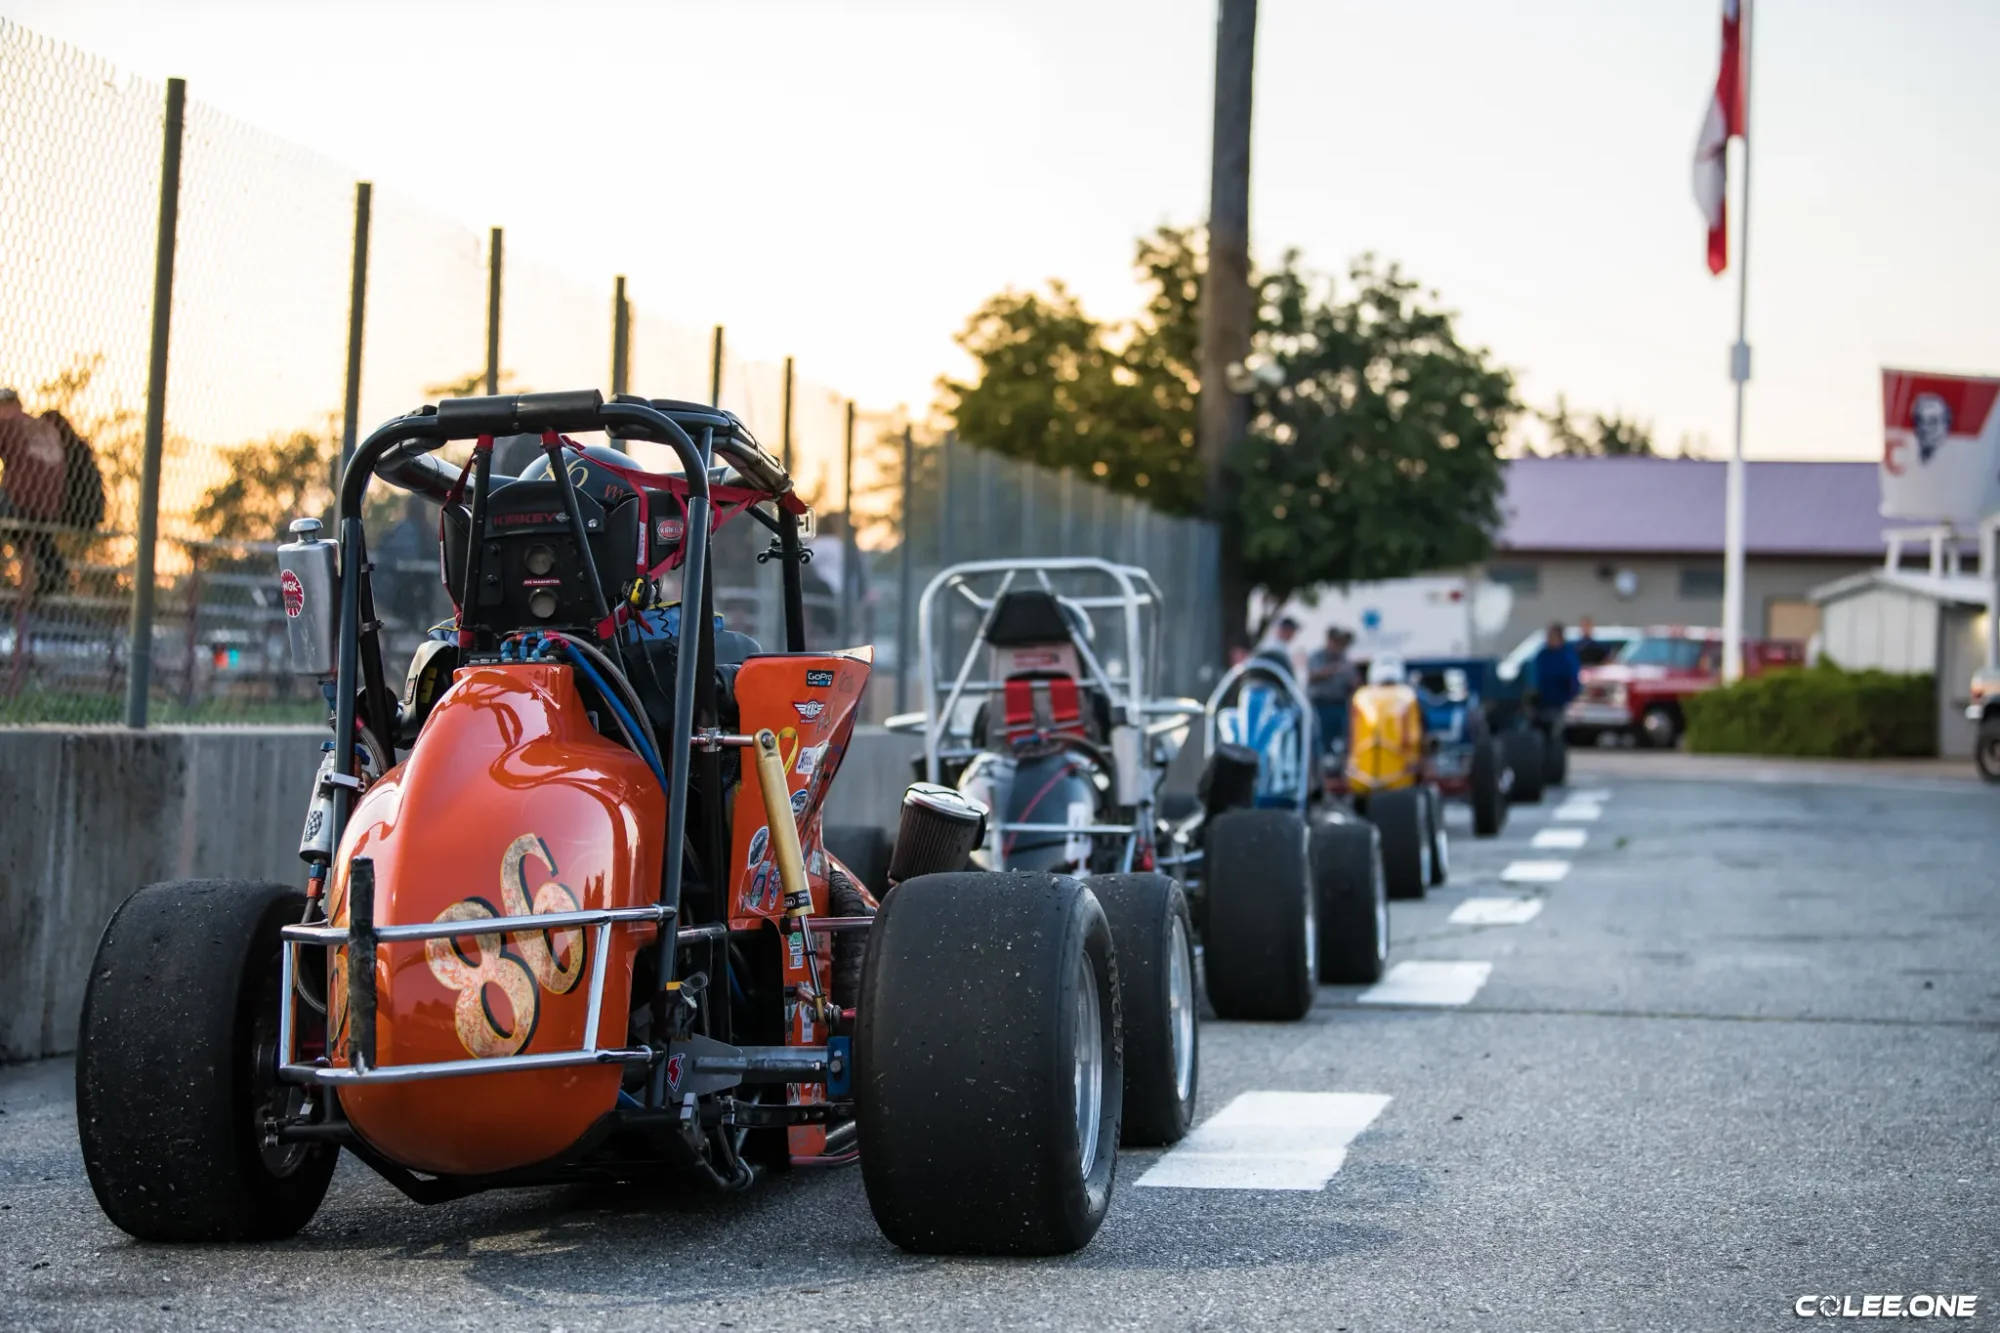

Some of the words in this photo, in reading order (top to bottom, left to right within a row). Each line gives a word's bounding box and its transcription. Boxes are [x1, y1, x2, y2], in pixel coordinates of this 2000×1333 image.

[282, 581, 298, 592] NGK
[808, 672, 832, 681] GoPro
[425, 833, 587, 1060] 86
